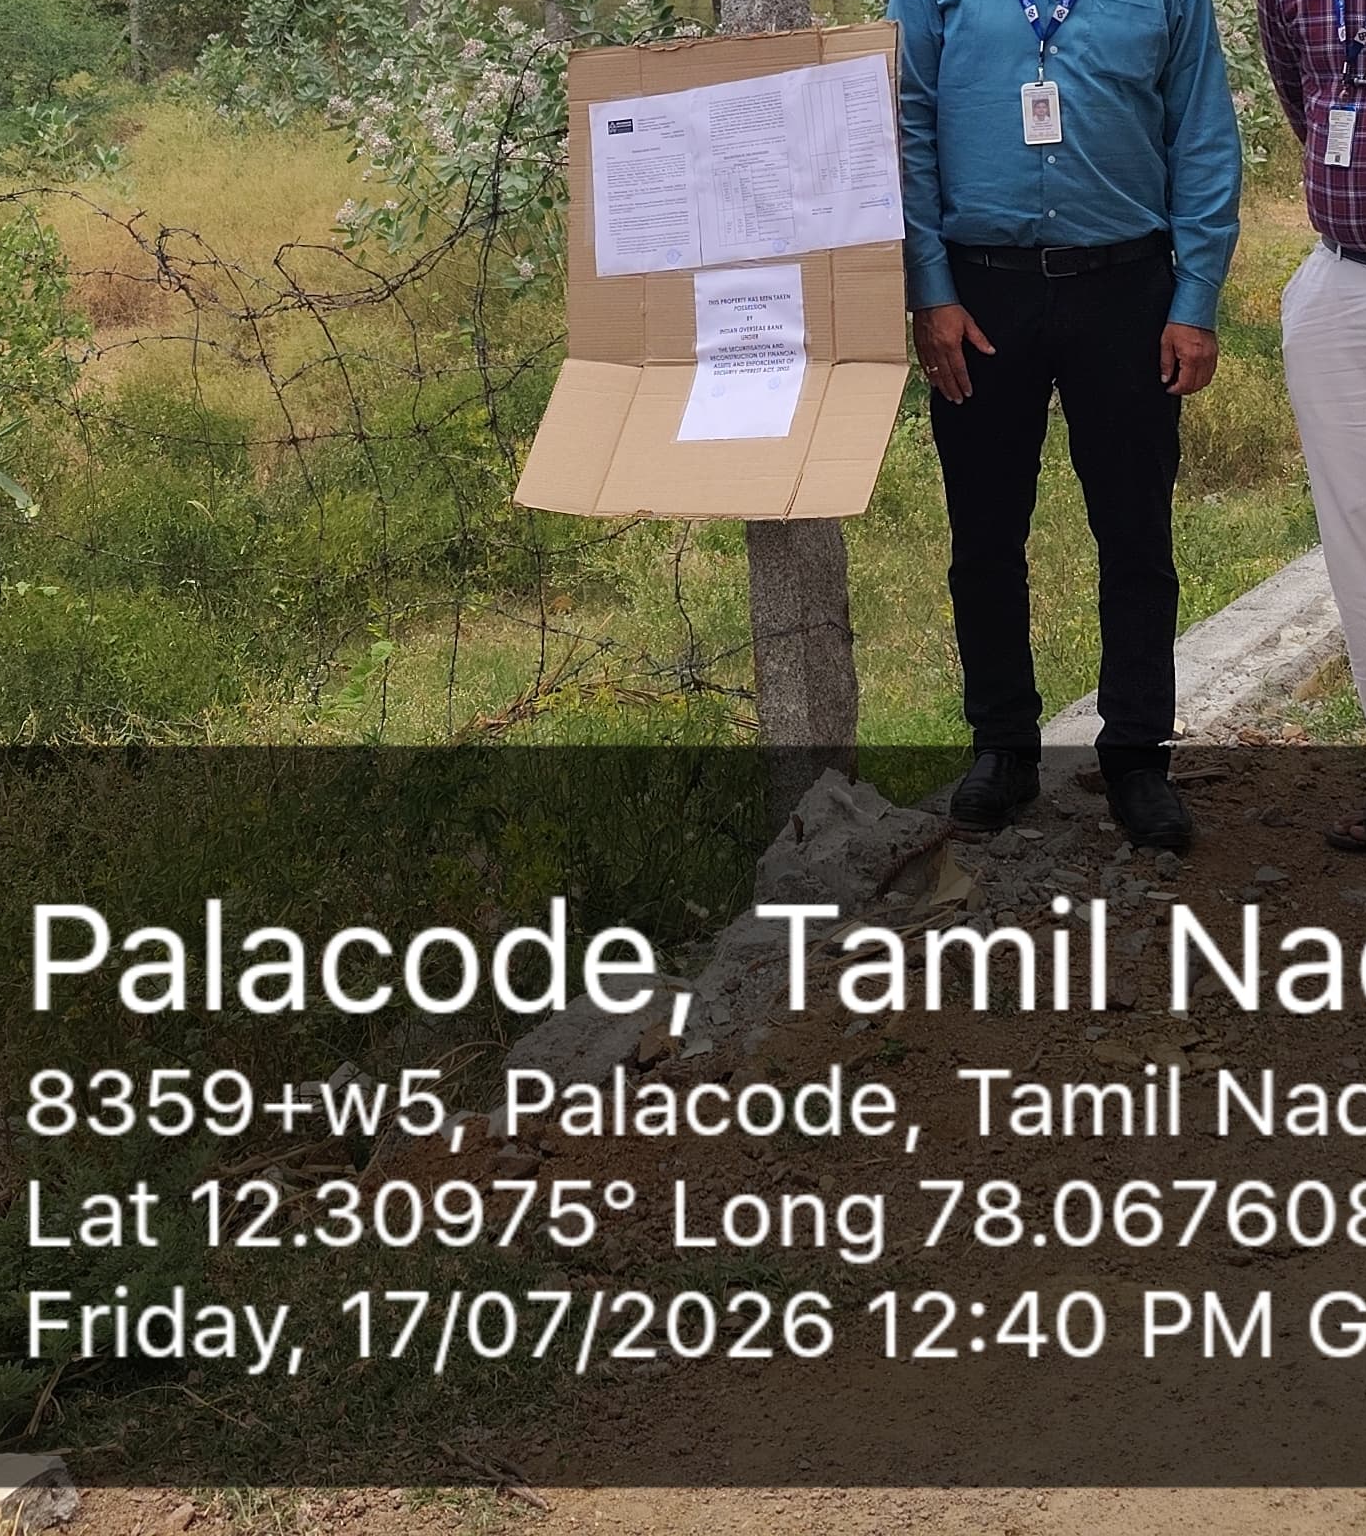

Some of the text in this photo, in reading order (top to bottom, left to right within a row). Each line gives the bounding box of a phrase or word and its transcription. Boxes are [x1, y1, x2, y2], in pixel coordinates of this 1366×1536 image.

[721, 297, 747, 305] PROPERTY
[734, 304, 767, 312] POSSESSION
[719, 327, 738, 335] INDIAN
[738, 325, 766, 333] OVERSEAS
[709, 350, 797, 361] RECONSTRUCTION OF FINANCIAL
[745, 358, 786, 367] ENFORCEMENT
